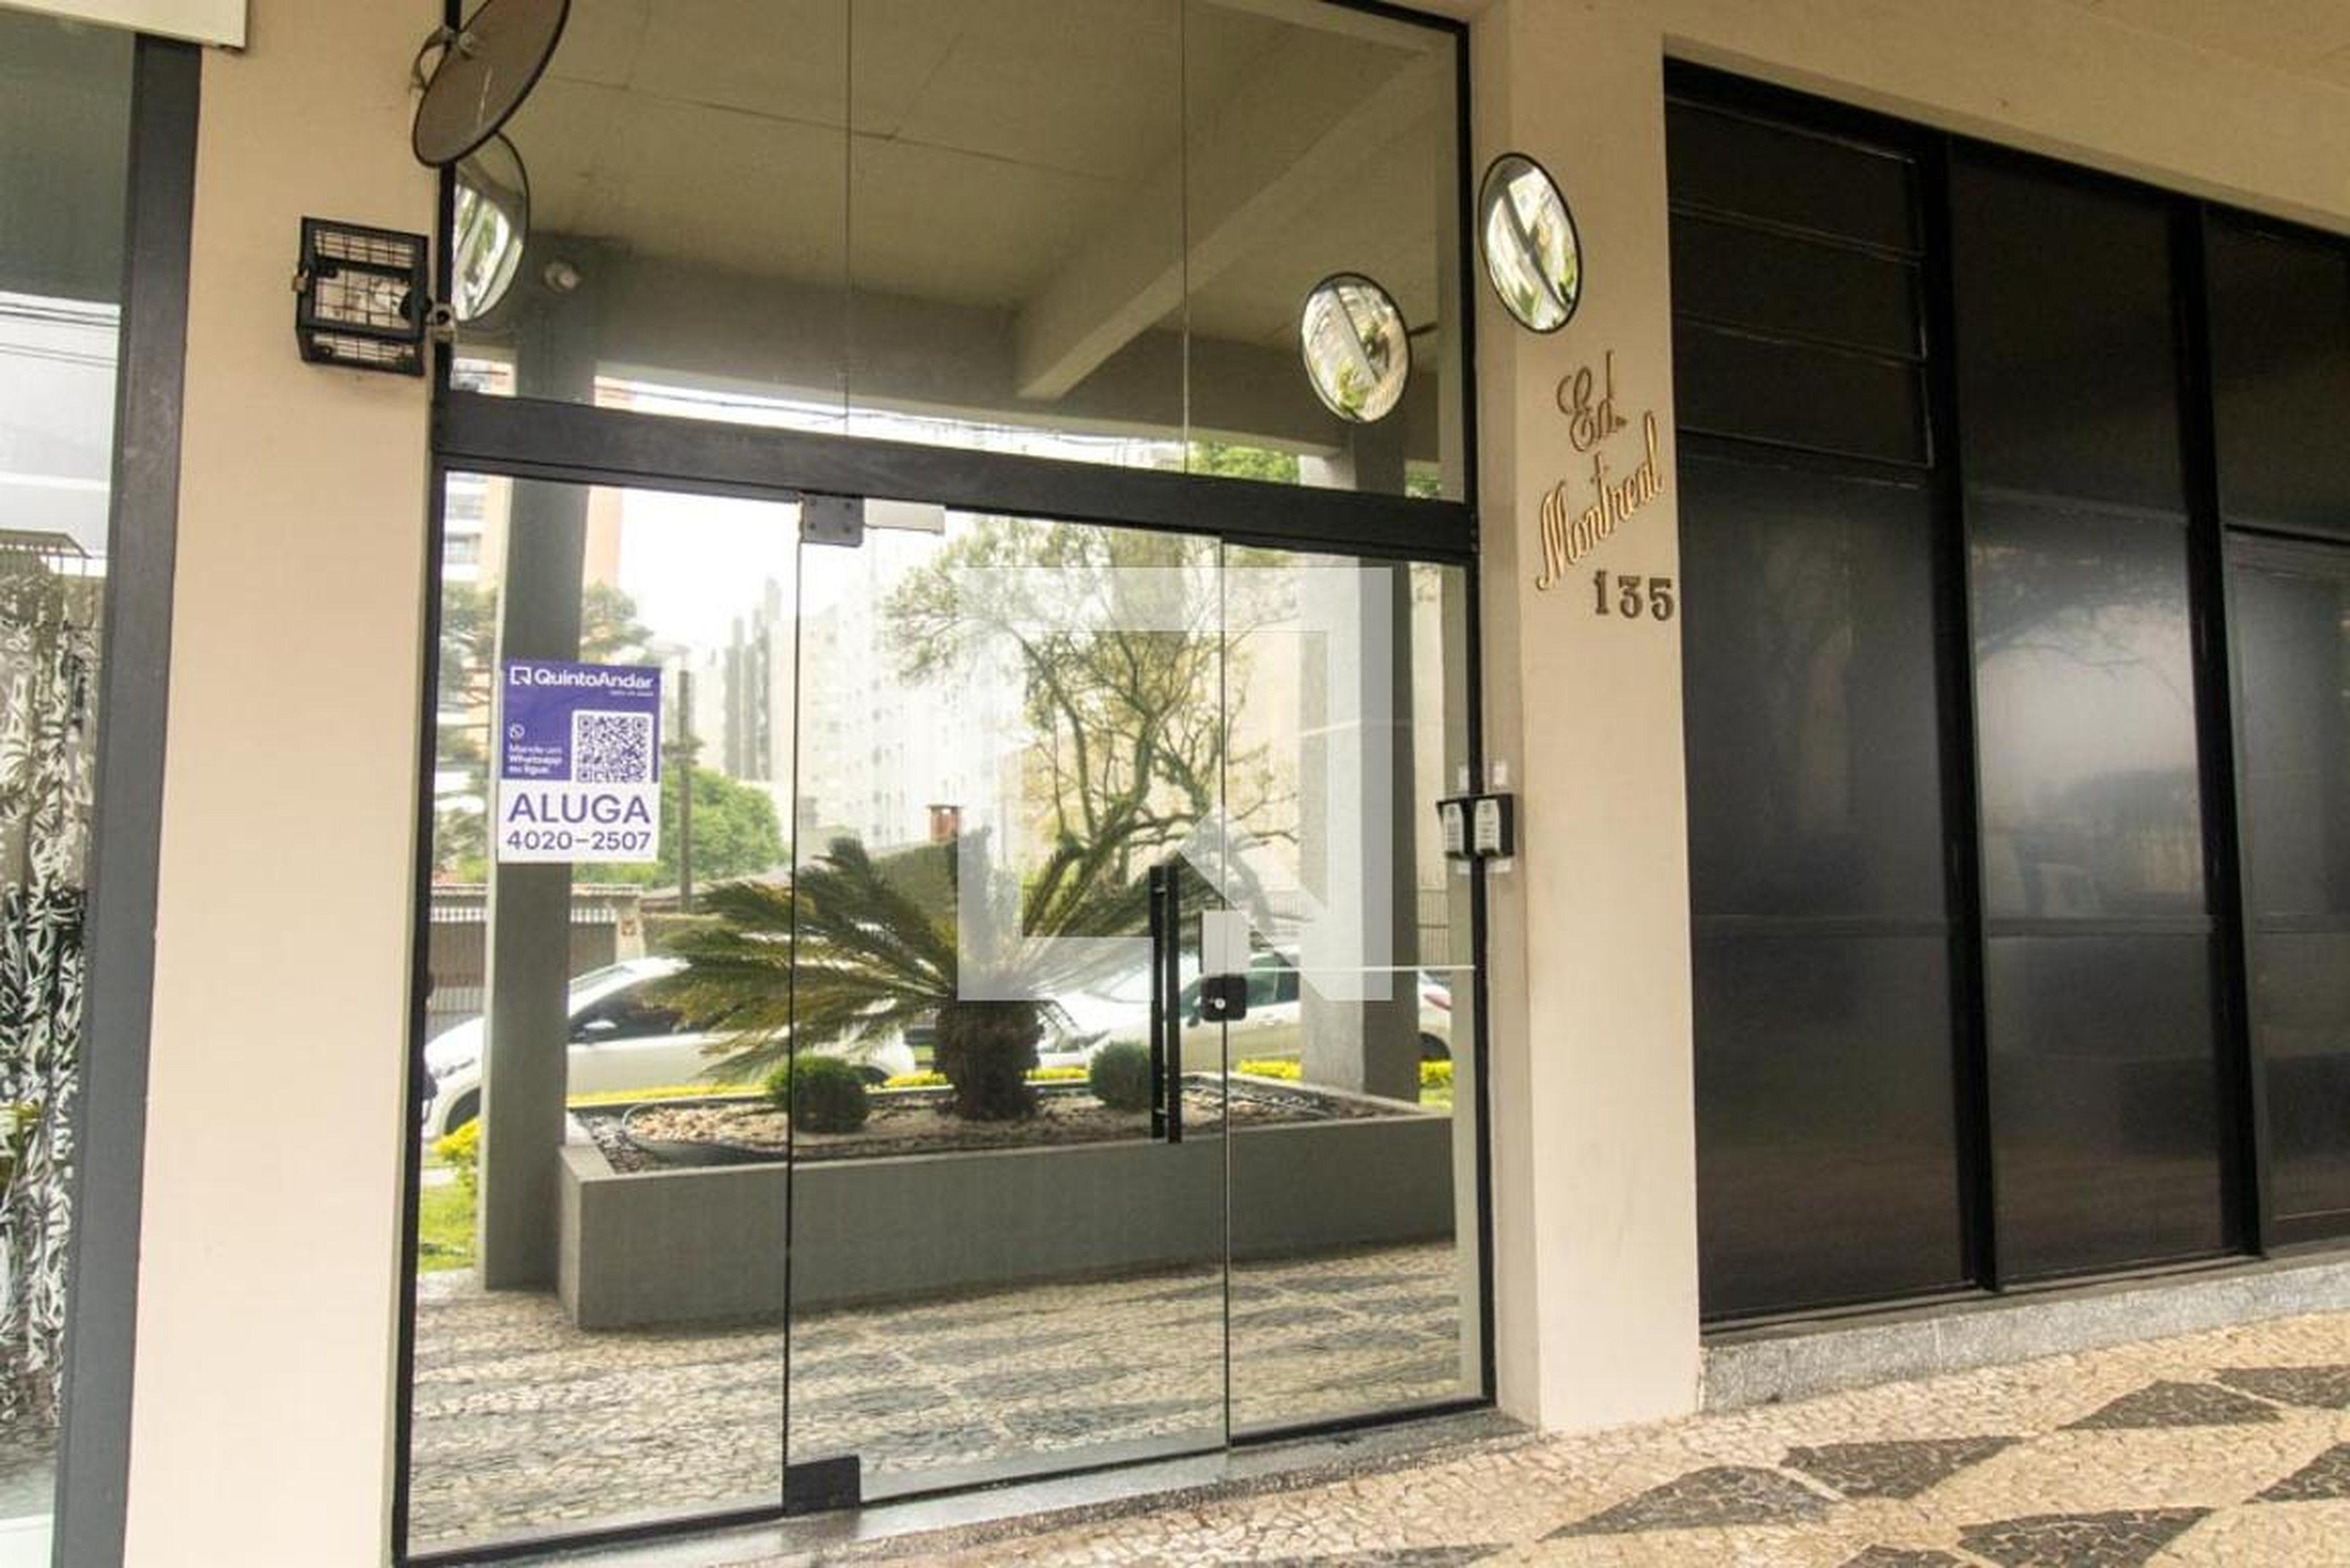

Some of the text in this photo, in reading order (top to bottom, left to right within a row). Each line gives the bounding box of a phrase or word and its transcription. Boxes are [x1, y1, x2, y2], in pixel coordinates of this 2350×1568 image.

[1557, 350, 1628, 452] Ed.
[1536, 411, 1663, 591] Montreal
[1594, 570, 1674, 621] 135
[534, 668, 654, 689] QuintoAndar
[507, 793, 651, 824] ALUGA
[506, 831, 652, 850] 4020-2507
